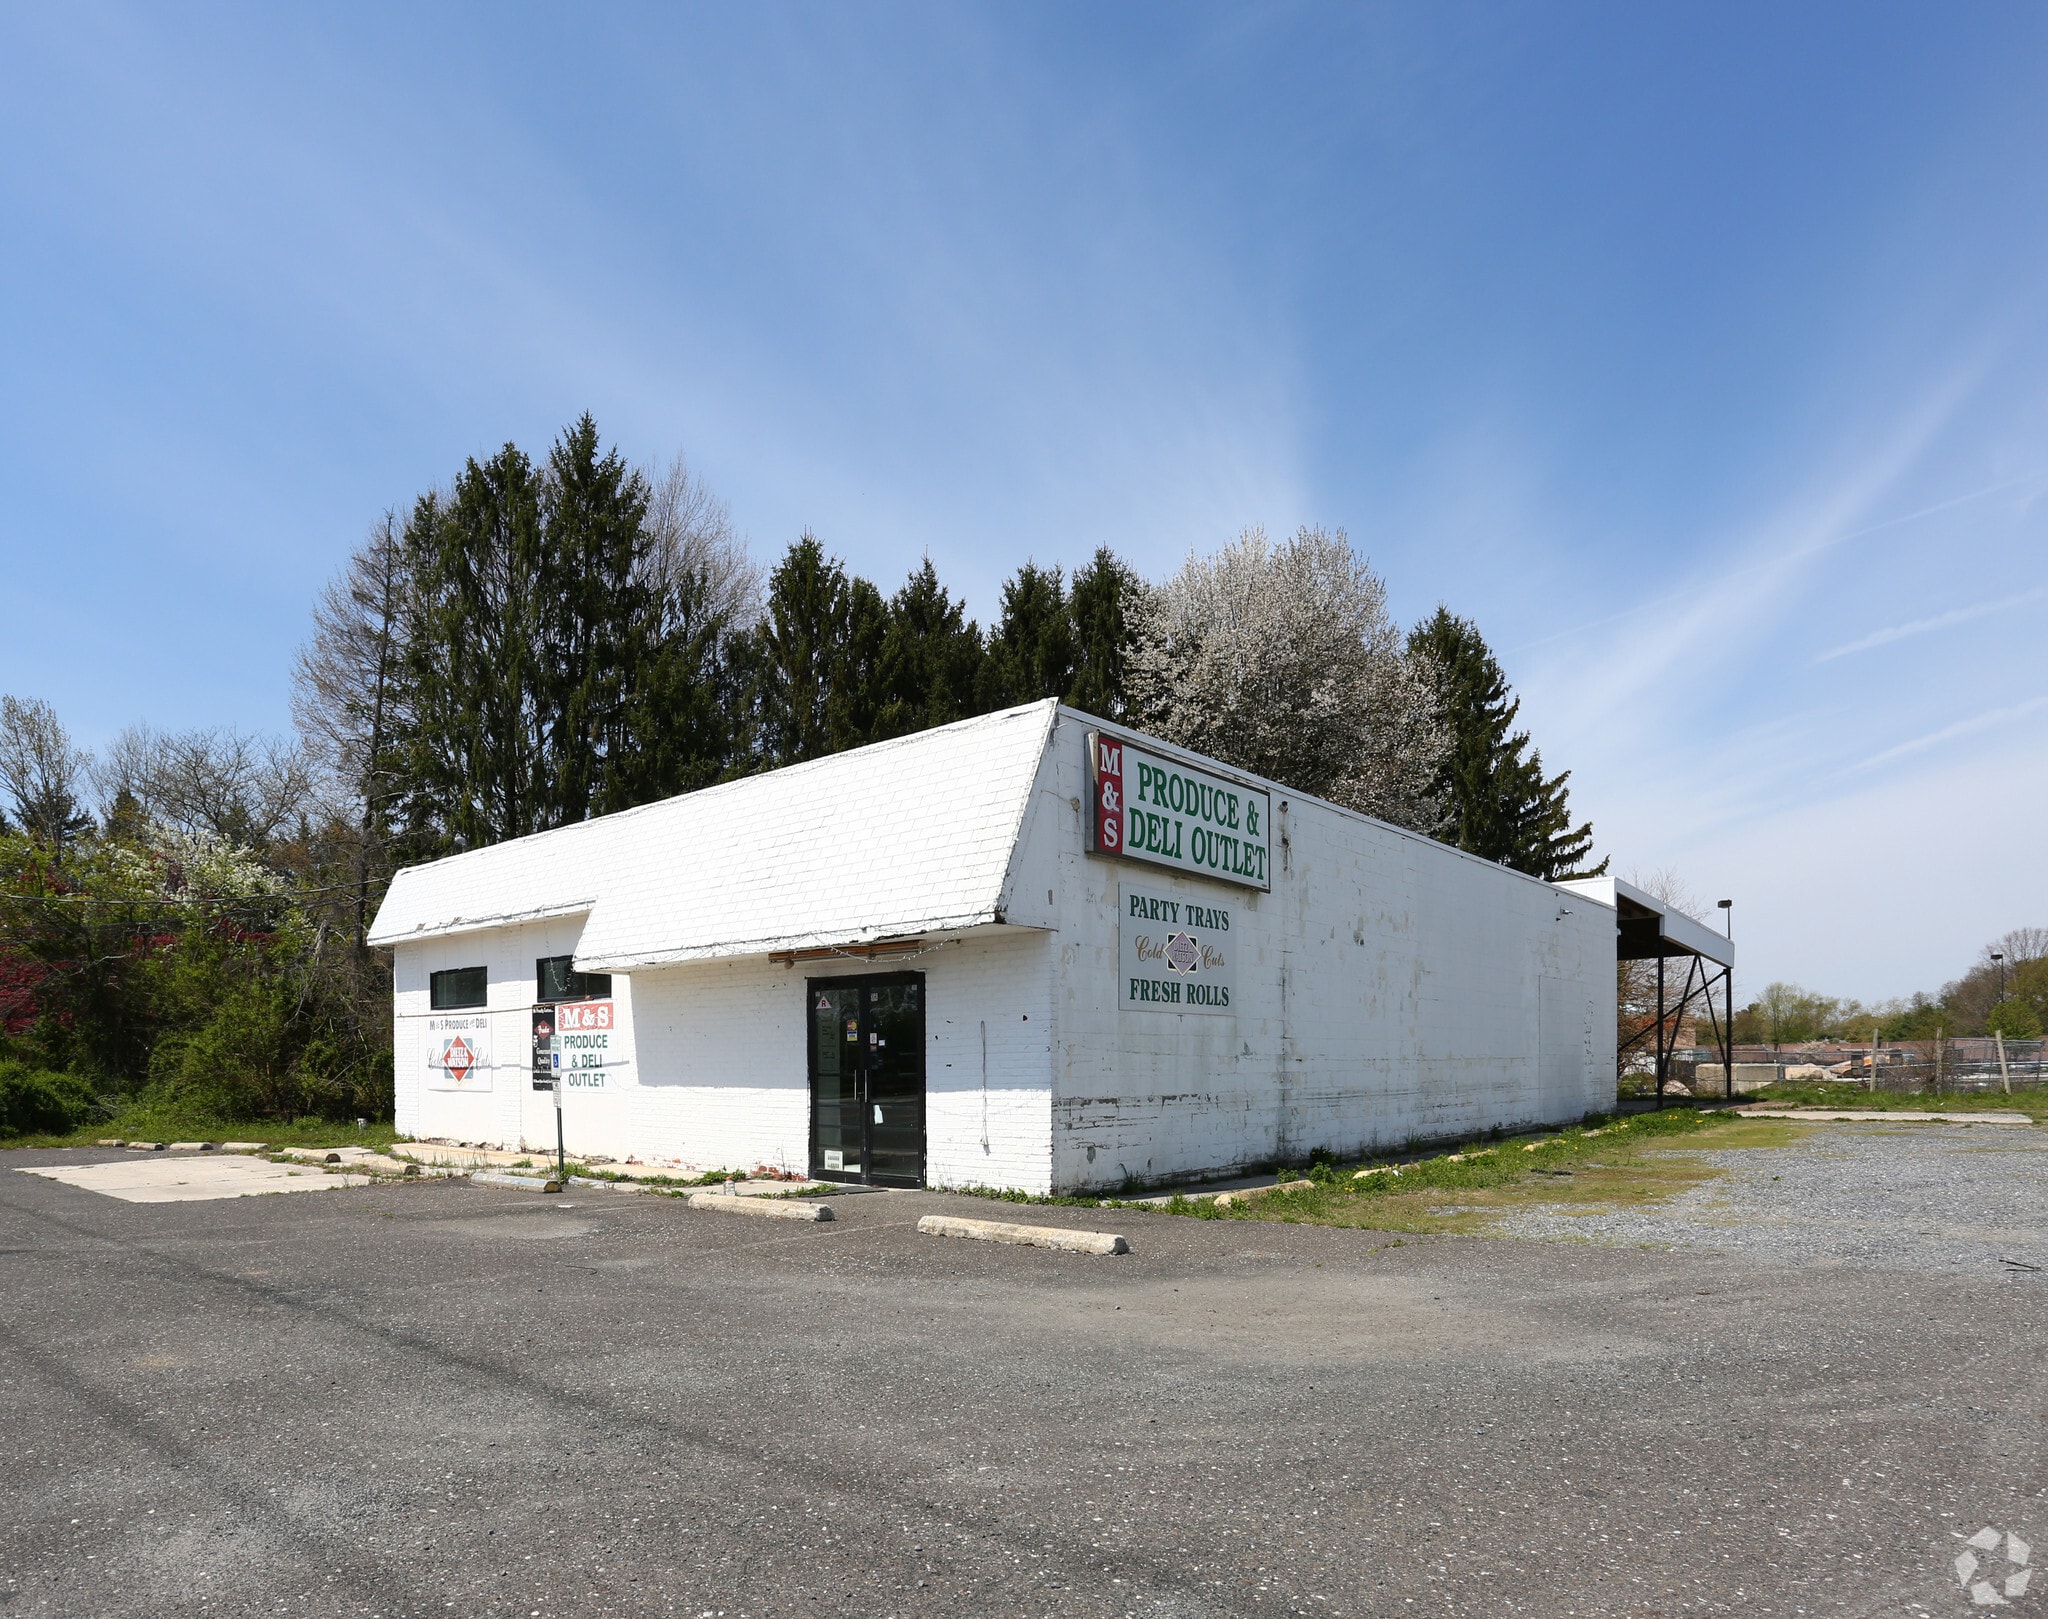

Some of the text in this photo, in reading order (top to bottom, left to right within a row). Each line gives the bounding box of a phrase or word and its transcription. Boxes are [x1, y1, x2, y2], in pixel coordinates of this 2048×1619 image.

[1137, 761, 1260, 837] PRODUCE &
[1129, 807, 1266, 880] DELI OUTLET
[1129, 894, 1229, 931] PARTY TRAYS
[1135, 935, 1225, 969] Cold Cuts
[1129, 978, 1229, 1007] FRESH ROLLS
[475, 1017, 488, 1029] DELI
[564, 1034, 608, 1049] PRODUCE
[571, 1054, 602, 1068] & DELI
[568, 1073, 605, 1087] OUTLET
